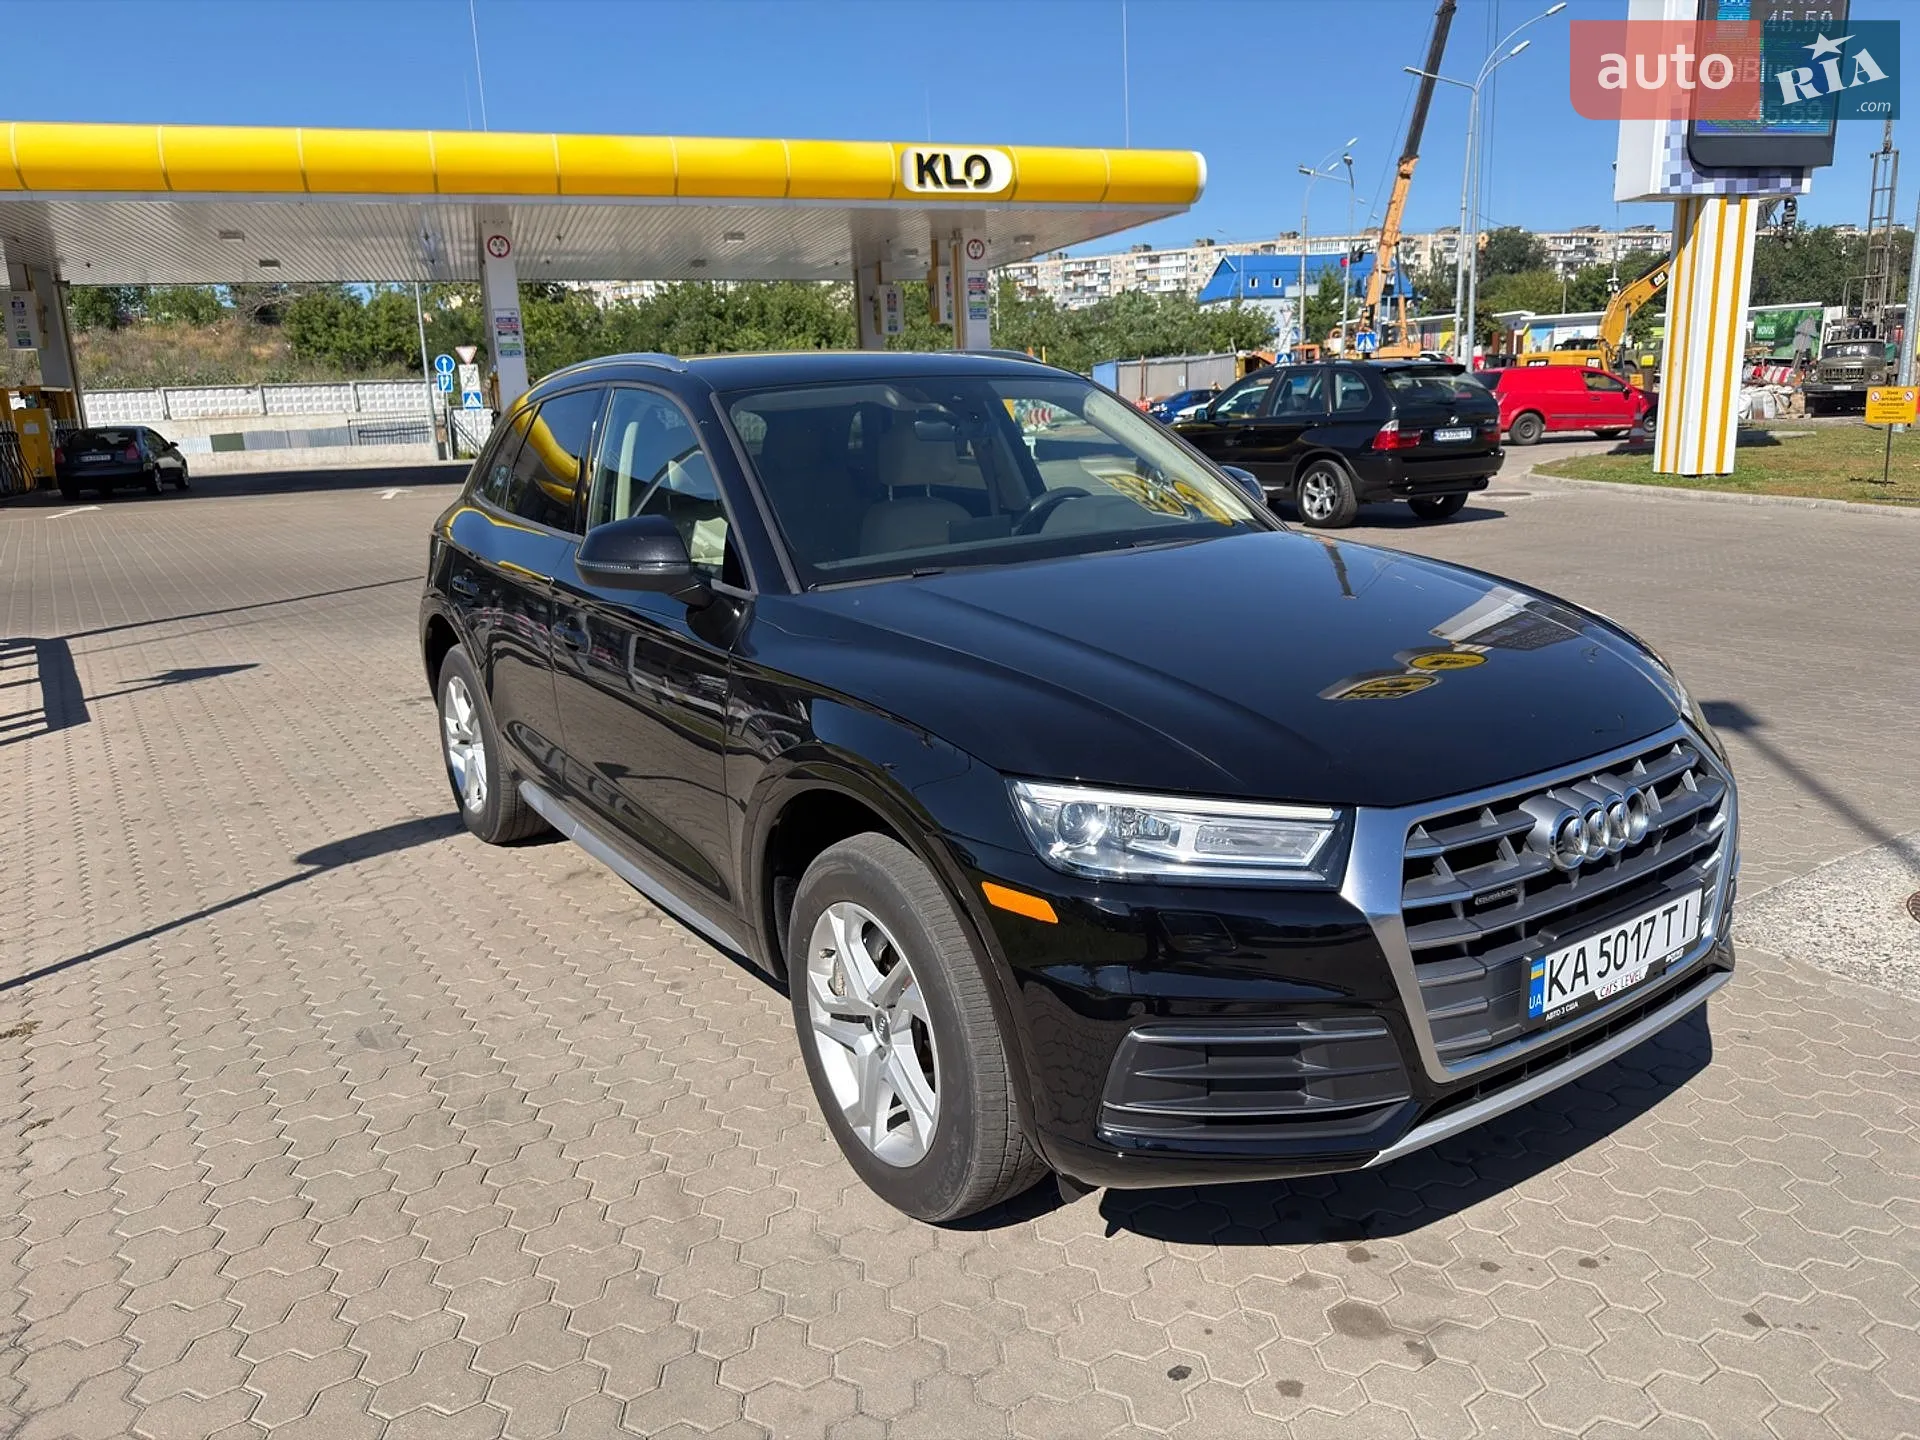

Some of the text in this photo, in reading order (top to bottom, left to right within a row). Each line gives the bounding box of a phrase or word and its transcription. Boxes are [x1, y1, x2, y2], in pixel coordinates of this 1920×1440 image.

[1764, 10, 1834, 33] 45.59
[915, 152, 992, 188] KLO
[1653, 272, 1665, 286] CAT
[1757, 325, 1775, 335] NOVUS
[1587, 358, 1600, 368] CAT
[1547, 899, 1690, 1003] KA 5017 TI
[1620, 970, 1644, 988] LEVEL
[1529, 995, 1543, 1010] UA
